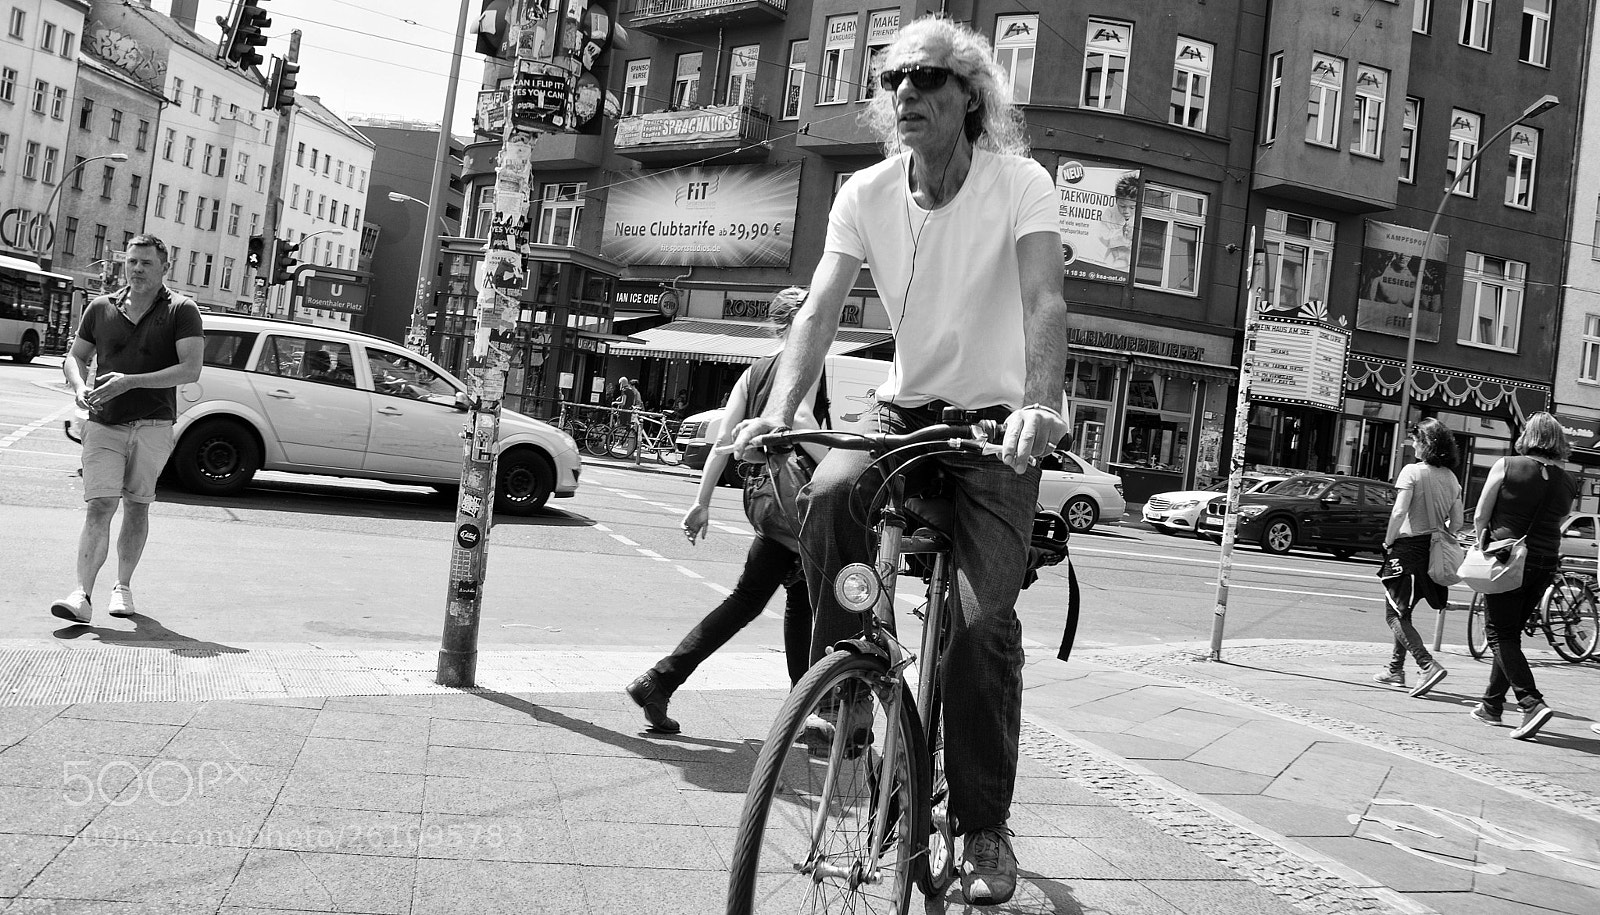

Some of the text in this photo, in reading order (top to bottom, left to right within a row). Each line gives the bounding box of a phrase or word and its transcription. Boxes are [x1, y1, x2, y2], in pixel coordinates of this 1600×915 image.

[873, 15, 899, 28] MAKE
[537, 81, 553, 89] FLIP
[555, 82, 564, 90] IT?
[513, 88, 526, 96] YES
[547, 91, 564, 100] CAN!
[662, 114, 739, 135] SPRACHKURSE
[1063, 167, 1083, 180] NEU!
[1060, 189, 1115, 207] TAEKWONDO
[1069, 206, 1103, 221] KINDER
[615, 220, 782, 240] Neue Clubtarife ab 29,90 €
[1386, 234, 1427, 246] KAMPFSPOR
[331, 283, 343, 297] U
[308, 296, 362, 311] Rosenthaler Platz
[630, 293, 642, 303] ICE
[644, 294, 659, 304] CRE
